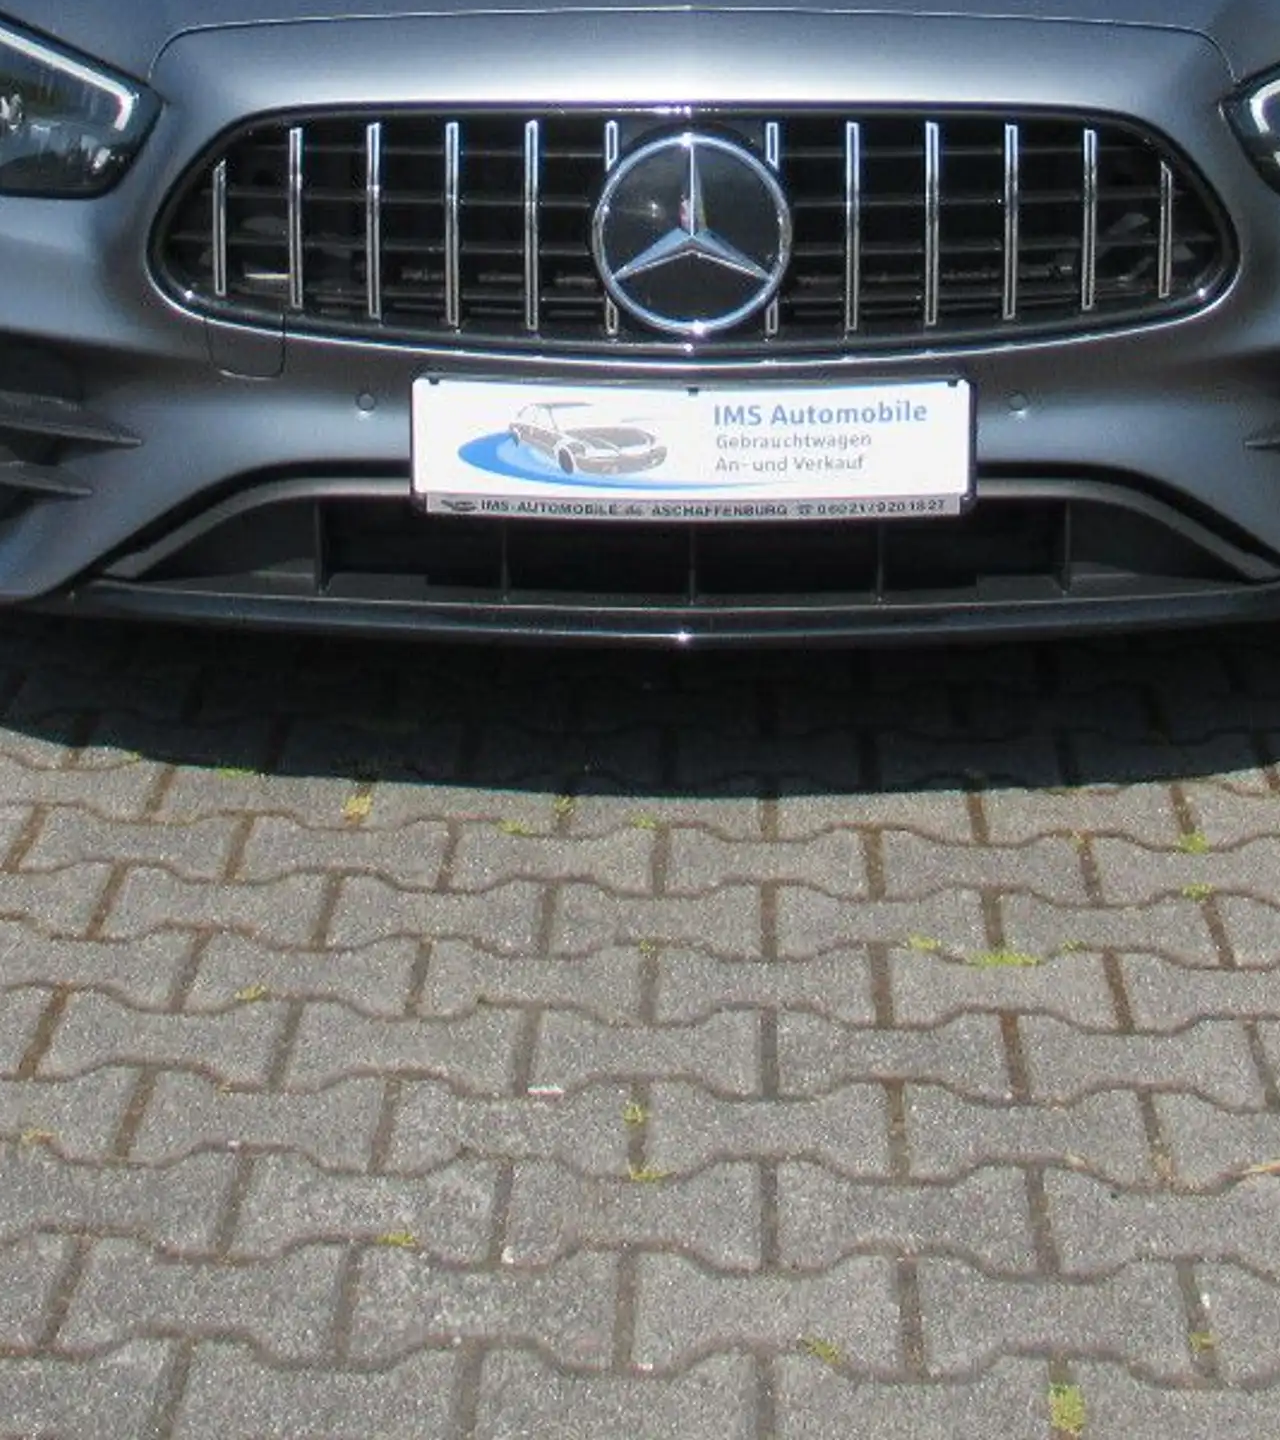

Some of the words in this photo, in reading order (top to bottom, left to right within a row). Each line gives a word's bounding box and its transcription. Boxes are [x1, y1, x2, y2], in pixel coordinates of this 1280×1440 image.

[713, 404, 762, 426] IMS
[770, 400, 928, 426] Automobile
[716, 433, 872, 450] Gebrauchtwagen
[753, 456, 788, 472] und
[793, 454, 865, 471] Verkauf
[651, 503, 788, 517] ASCHAFFENBURG
